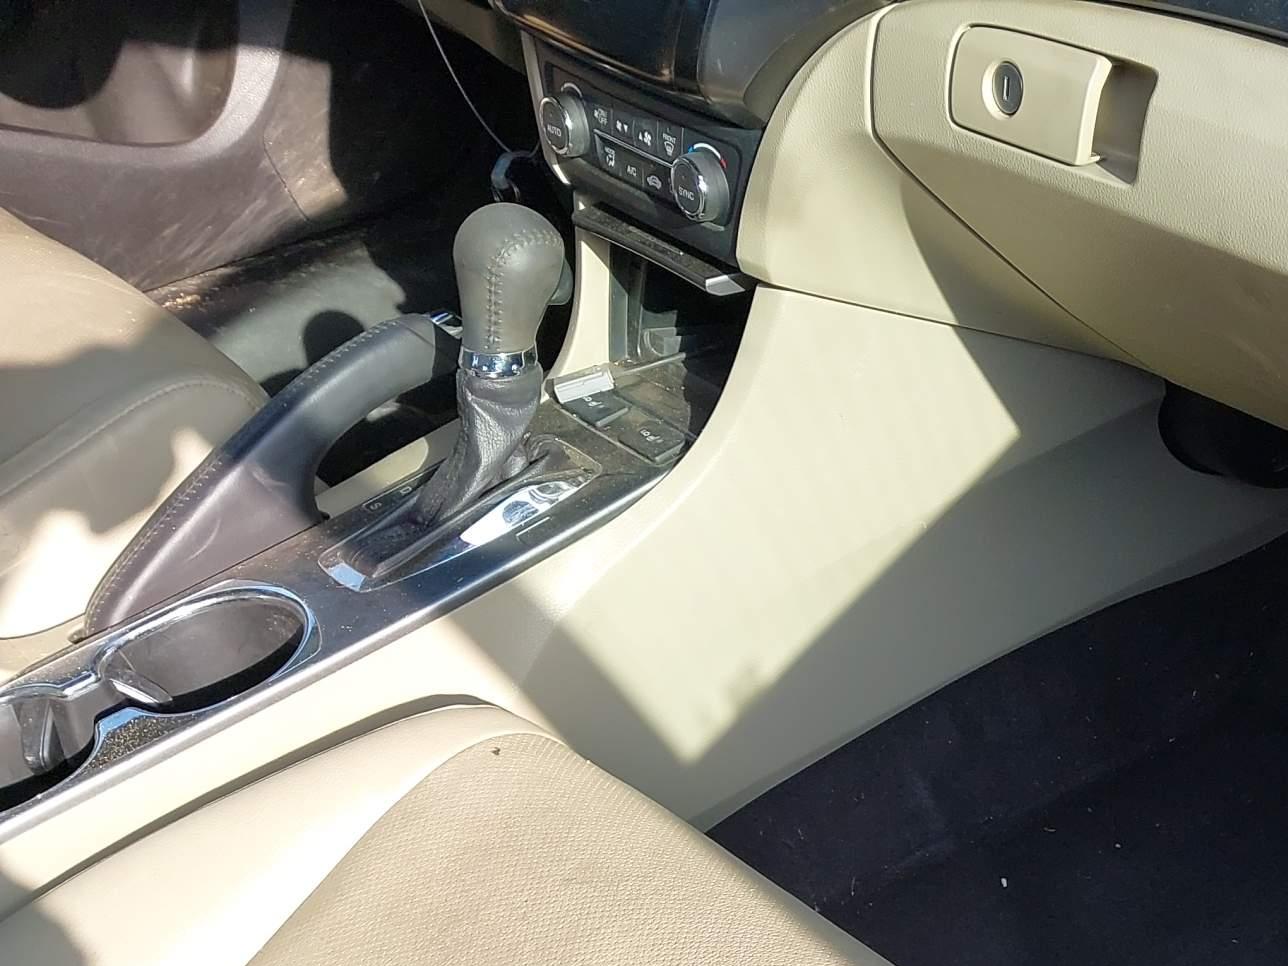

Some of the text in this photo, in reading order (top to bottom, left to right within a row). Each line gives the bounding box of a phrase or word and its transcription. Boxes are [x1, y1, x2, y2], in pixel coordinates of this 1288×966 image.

[547, 124, 562, 137] AUTO
[626, 165, 637, 177] A/C
[678, 186, 695, 201] SYNC
[370, 502, 382, 510] S
